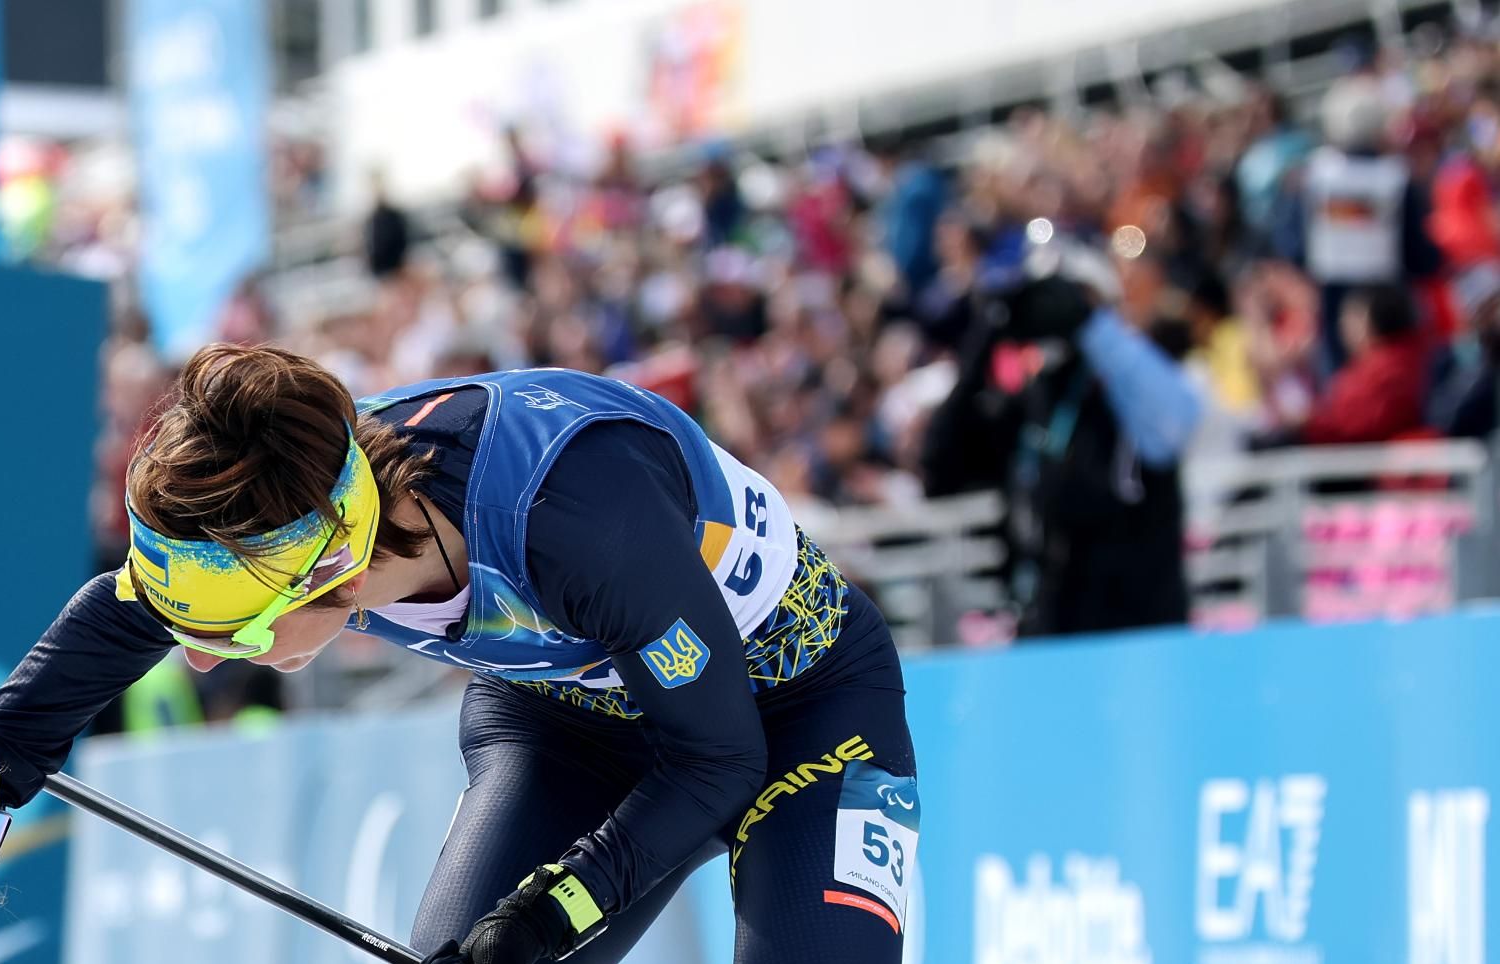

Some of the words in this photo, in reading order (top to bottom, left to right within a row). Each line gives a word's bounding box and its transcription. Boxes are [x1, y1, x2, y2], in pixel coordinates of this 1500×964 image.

[140, 576, 190, 613] RAINE
[731, 735, 875, 905] KRAINE
[846, 871, 880, 888] MILANO
[862, 820, 904, 888] 53
[1196, 774, 1328, 941] EA7
[361, 932, 391, 952] REDLINE
